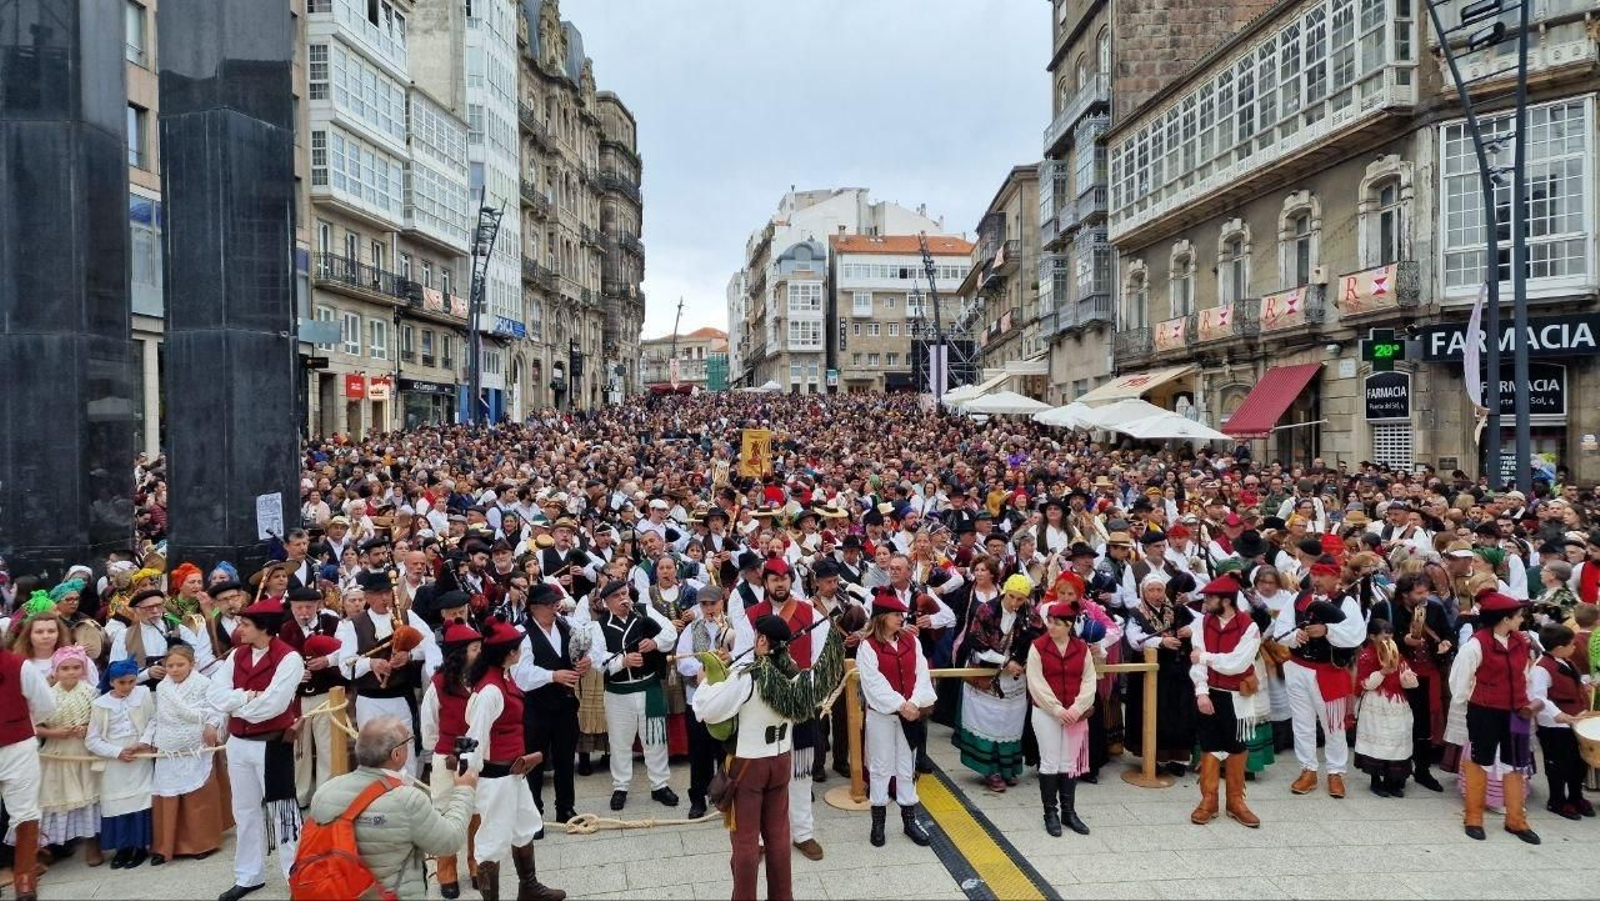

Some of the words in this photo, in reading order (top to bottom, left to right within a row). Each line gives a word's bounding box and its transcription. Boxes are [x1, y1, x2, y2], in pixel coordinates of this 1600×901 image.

[1346, 276, 1360, 300] R
[1265, 298, 1276, 319] R
[1431, 322, 1596, 356] FARMACIA
[1366, 385, 1407, 399] FARMACIA
